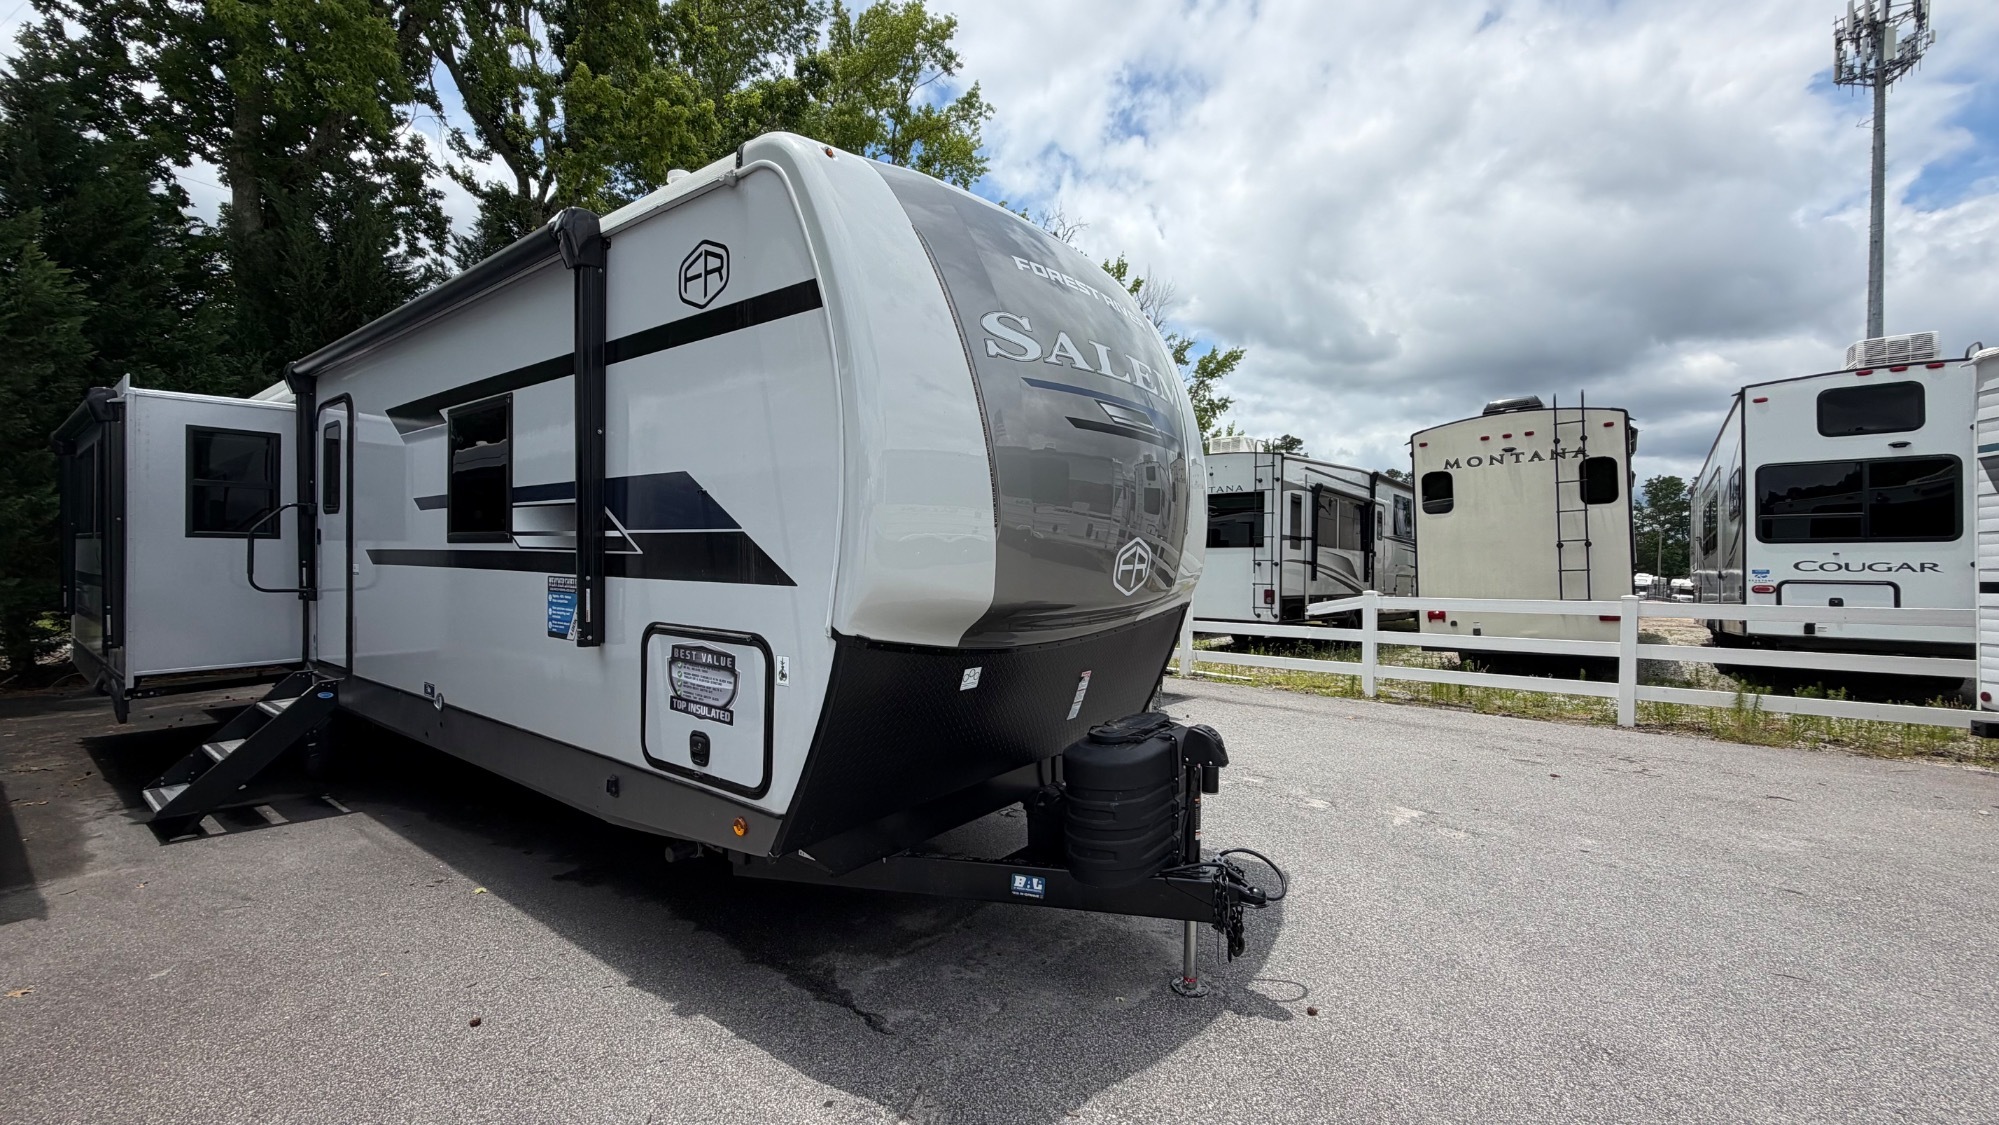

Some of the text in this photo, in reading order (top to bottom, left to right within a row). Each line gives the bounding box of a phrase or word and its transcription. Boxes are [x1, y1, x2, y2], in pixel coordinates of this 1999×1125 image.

[1012, 255, 1147, 332] FOREST RIVER
[980, 311, 1182, 412] SALEM
[1444, 447, 1589, 470] MONTANA
[1793, 560, 1944, 574] COUGAR
[673, 648, 733, 668] BEST VALUE
[672, 698, 731, 722] TOP INSULATED
